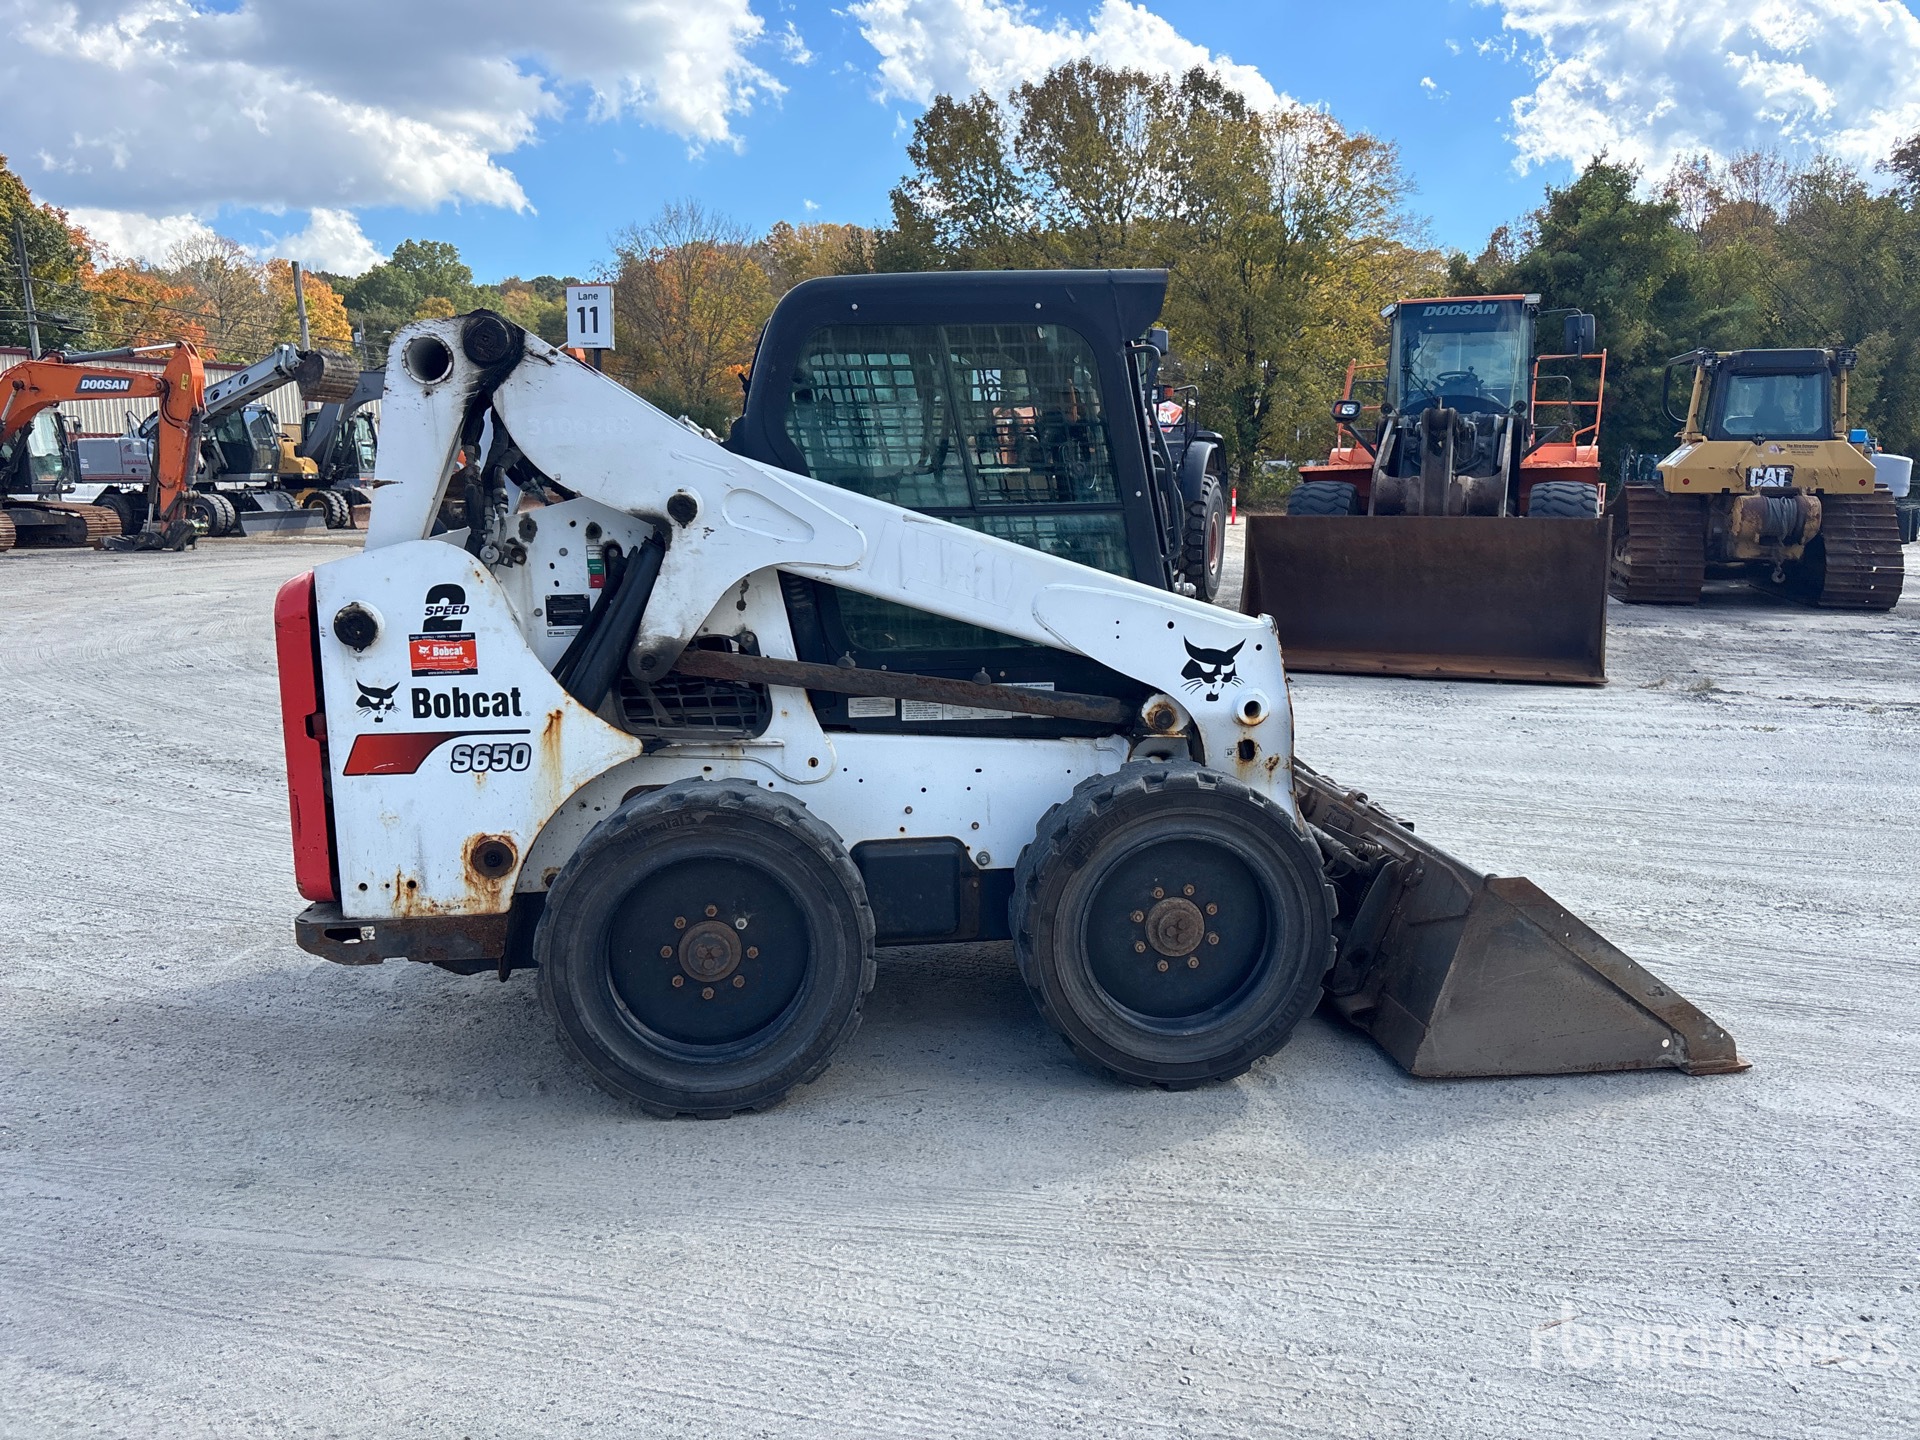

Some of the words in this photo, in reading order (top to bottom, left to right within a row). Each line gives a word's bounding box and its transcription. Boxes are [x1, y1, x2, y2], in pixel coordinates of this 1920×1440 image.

[577, 292, 599, 301] Lane
[1422, 303, 1499, 317] DOOSAN
[576, 306, 599, 334] 11
[80, 379, 130, 390] DOOSAN
[1749, 467, 1789, 488] CAT
[422, 583, 467, 632] 2
[424, 605, 470, 616] SPEED
[432, 645, 464, 657] Bobcat
[411, 687, 522, 718] Bobcat
[450, 742, 532, 774] S650
